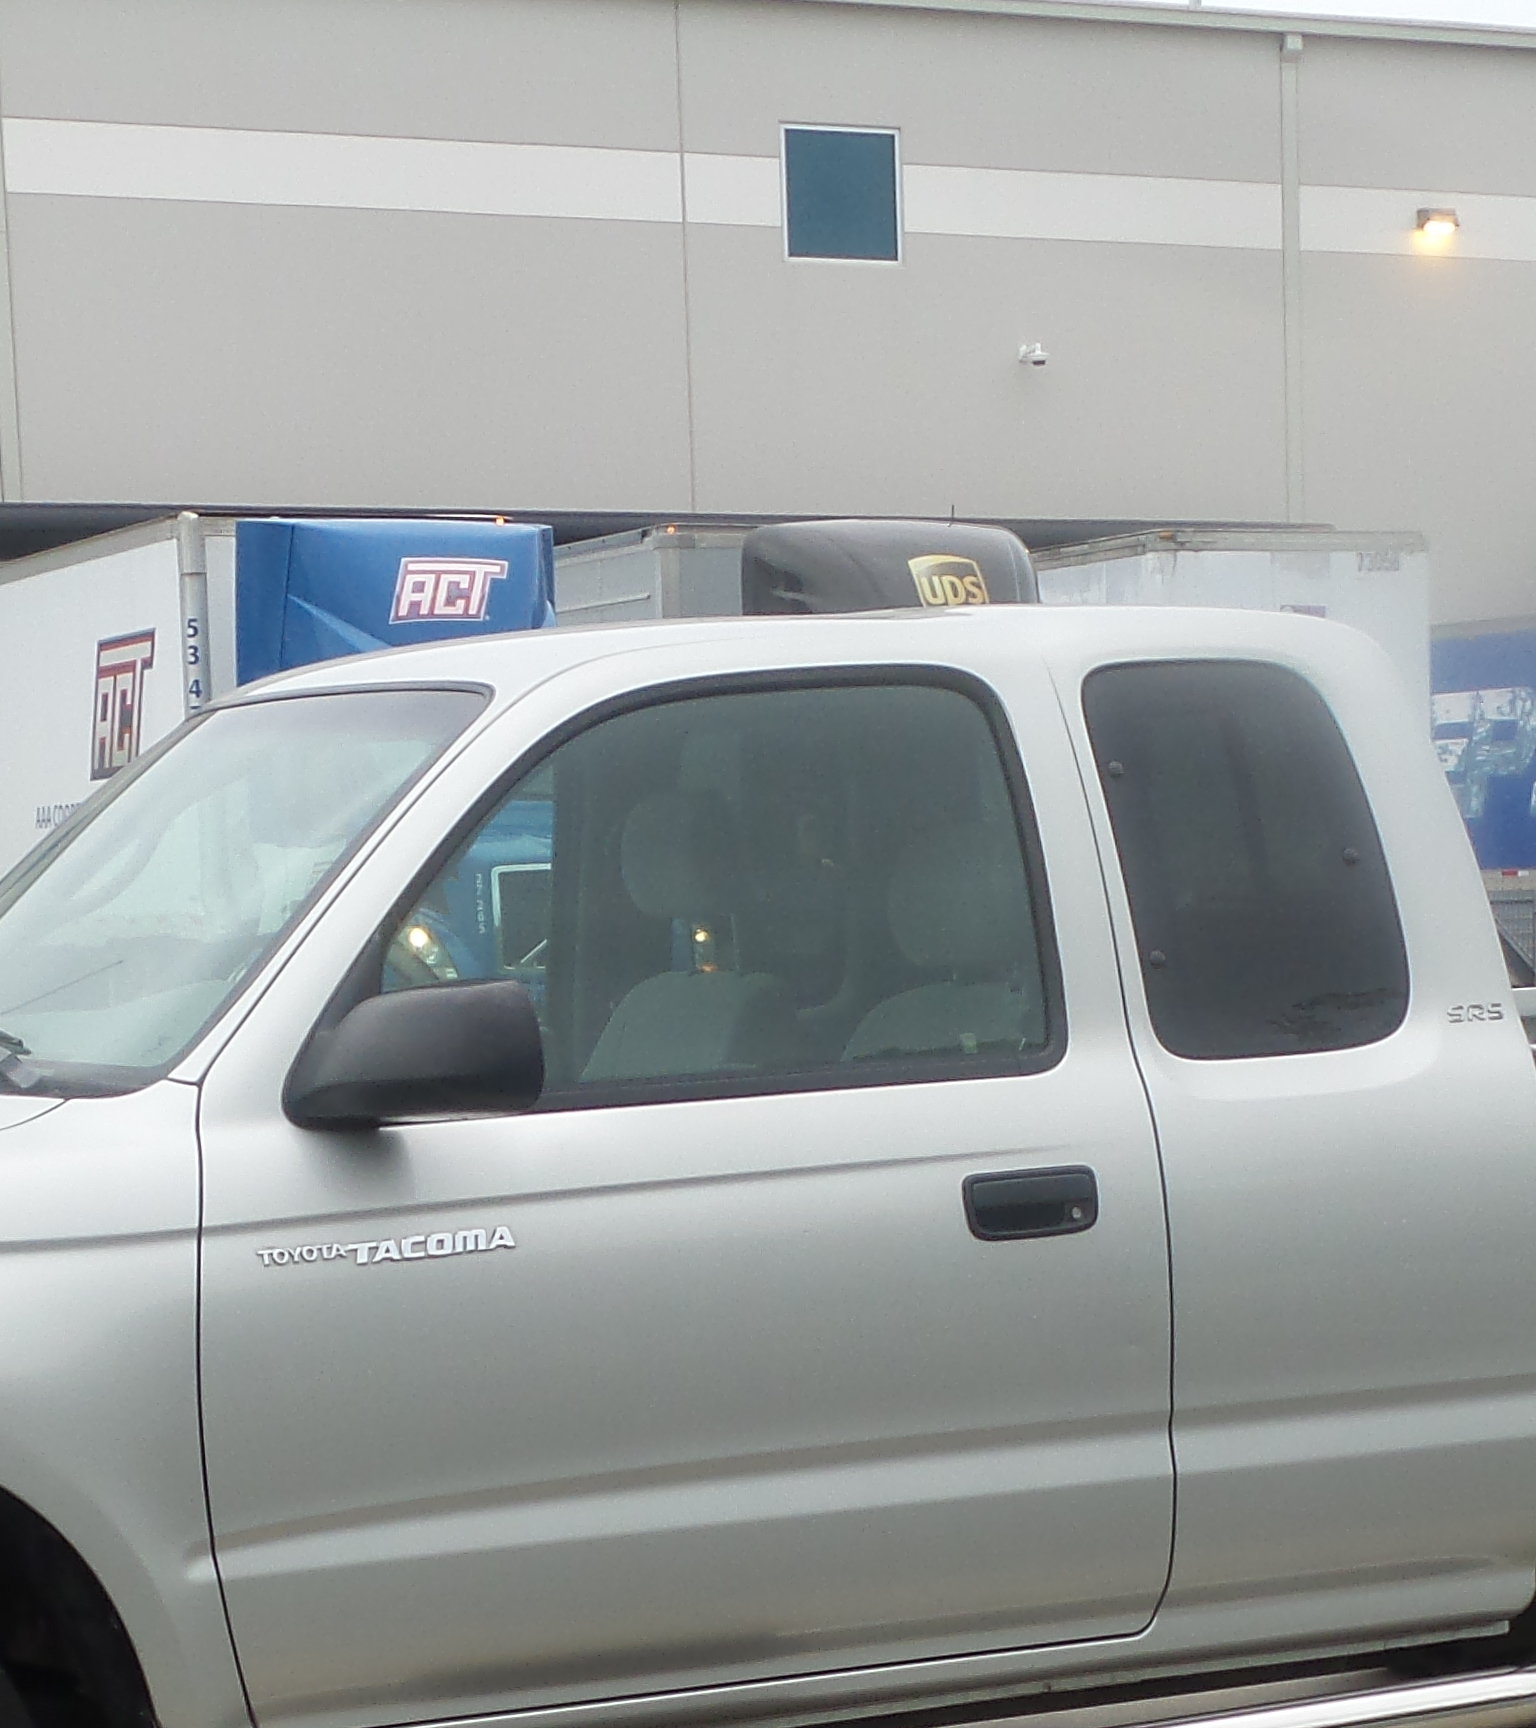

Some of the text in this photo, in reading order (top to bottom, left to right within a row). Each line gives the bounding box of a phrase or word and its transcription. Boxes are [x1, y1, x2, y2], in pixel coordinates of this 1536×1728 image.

[395, 560, 503, 618] ACT
[93, 637, 154, 771] ACT
[35, 806, 52, 829] AAA
[258, 1226, 516, 1267] TOYOTA TACOMA
